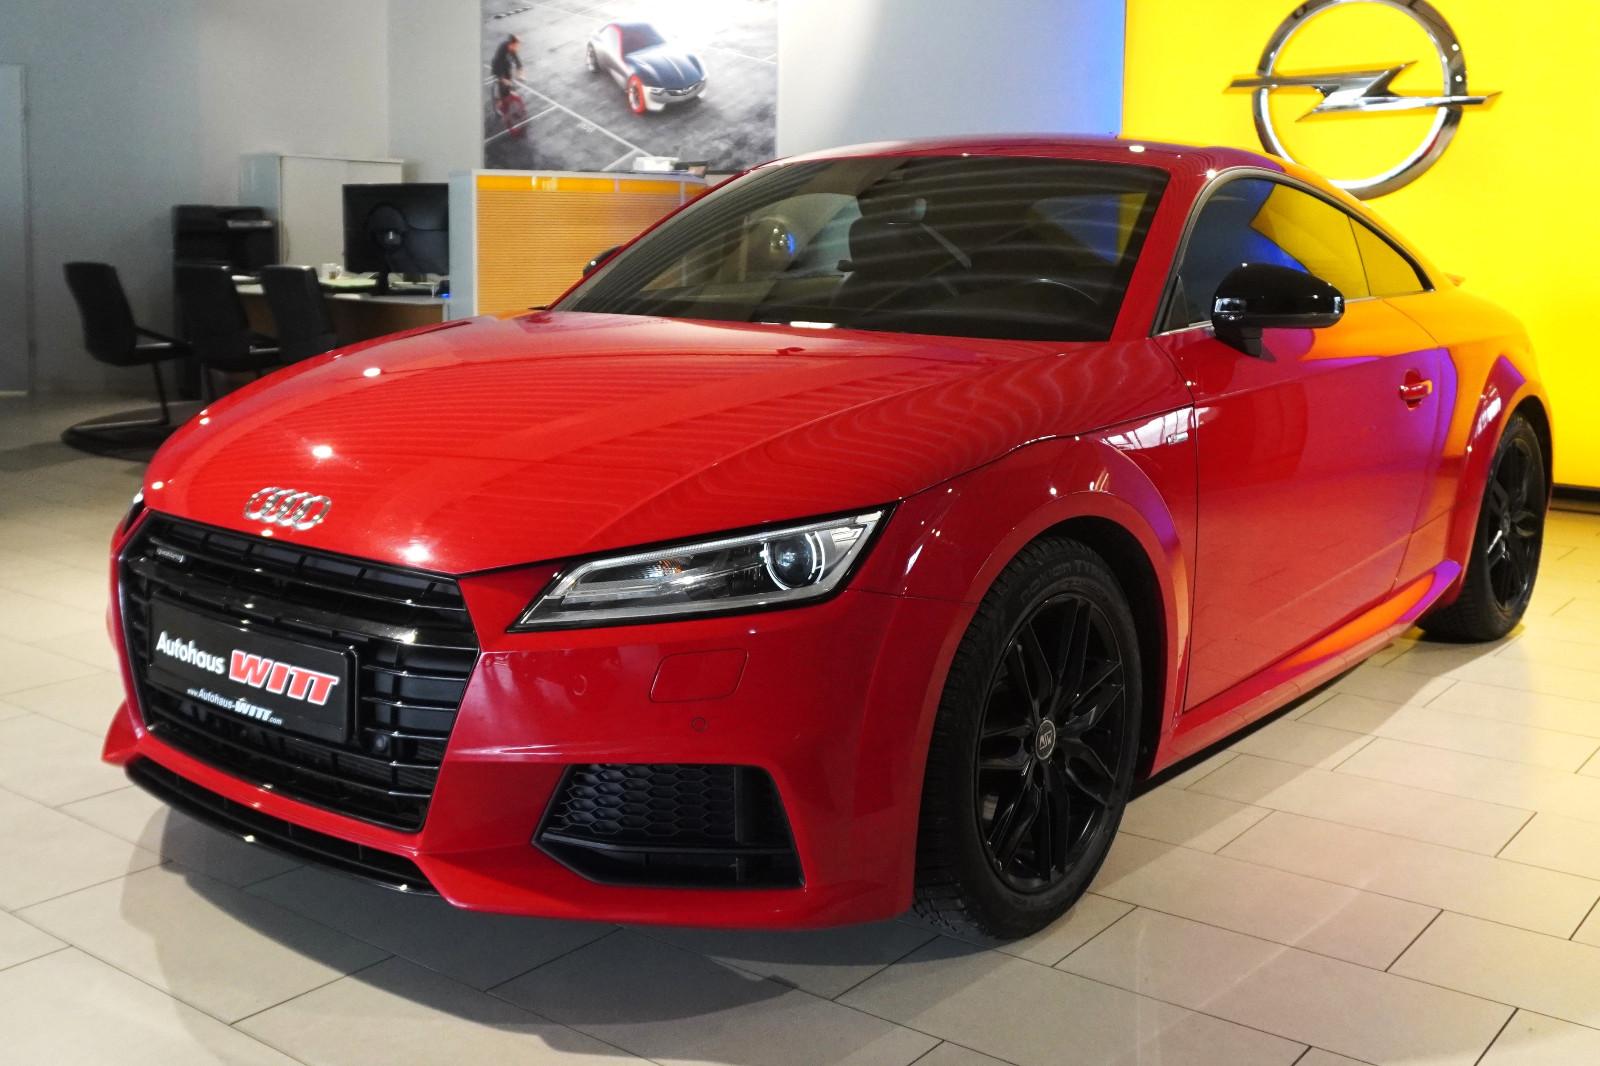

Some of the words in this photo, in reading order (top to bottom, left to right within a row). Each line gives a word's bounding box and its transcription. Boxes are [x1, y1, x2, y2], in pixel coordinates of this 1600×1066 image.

[156, 631, 225, 674] Autohaus
[229, 649, 339, 706] WITT
[187, 688, 282, 725] www.Autohaus-WITT.com
